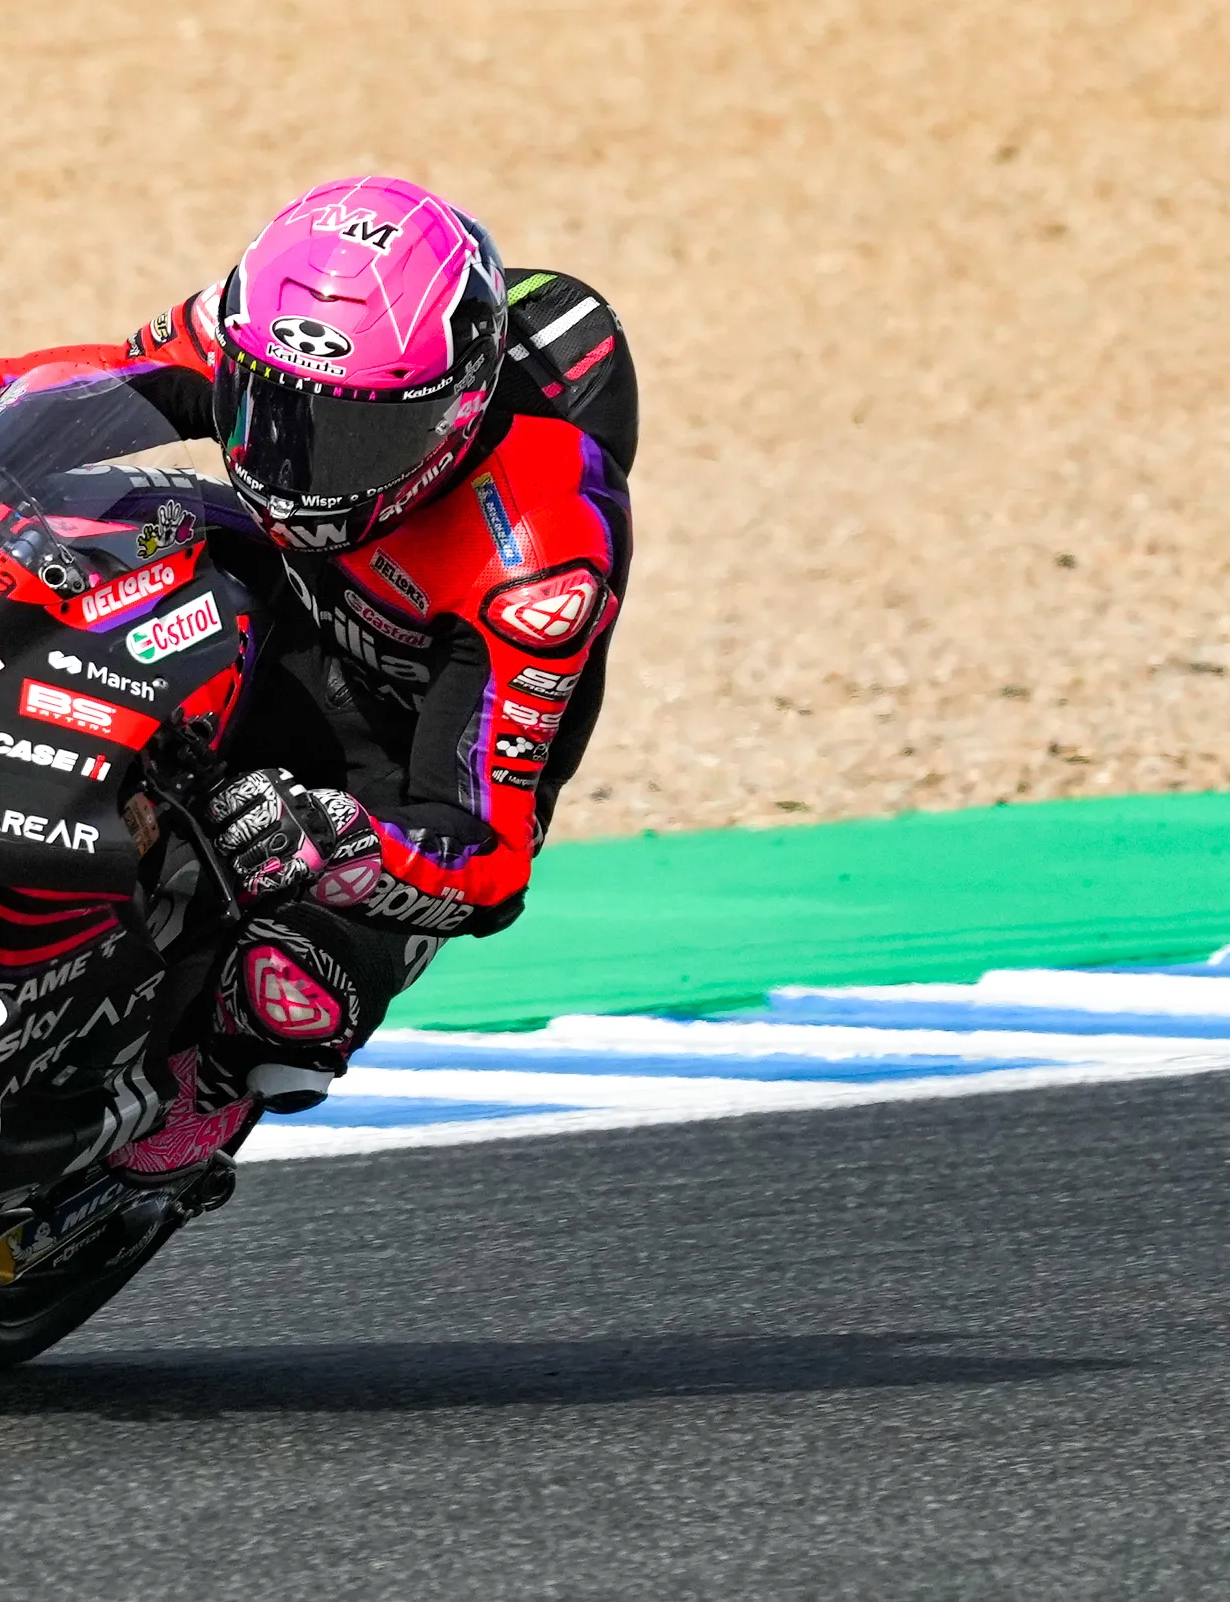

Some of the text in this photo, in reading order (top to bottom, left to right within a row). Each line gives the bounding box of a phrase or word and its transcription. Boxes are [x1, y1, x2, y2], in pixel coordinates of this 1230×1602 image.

[237, 352, 271, 379] MAX
[332, 386, 377, 401] MIA
[269, 344, 344, 376] Kabuto
[403, 376, 454, 400] Kabuto
[234, 463, 265, 492] Wispr
[378, 452, 455, 523] aprilia
[301, 495, 343, 509] Wispr
[82, 564, 175, 623] DELLORTO
[361, 607, 426, 647] Castrol
[86, 662, 155, 701] Marsh
[26, 706, 112, 734] BATTERY
[27, 684, 114, 727] BS
[503, 700, 566, 729] BS
[366, 872, 474, 931] aprilia
